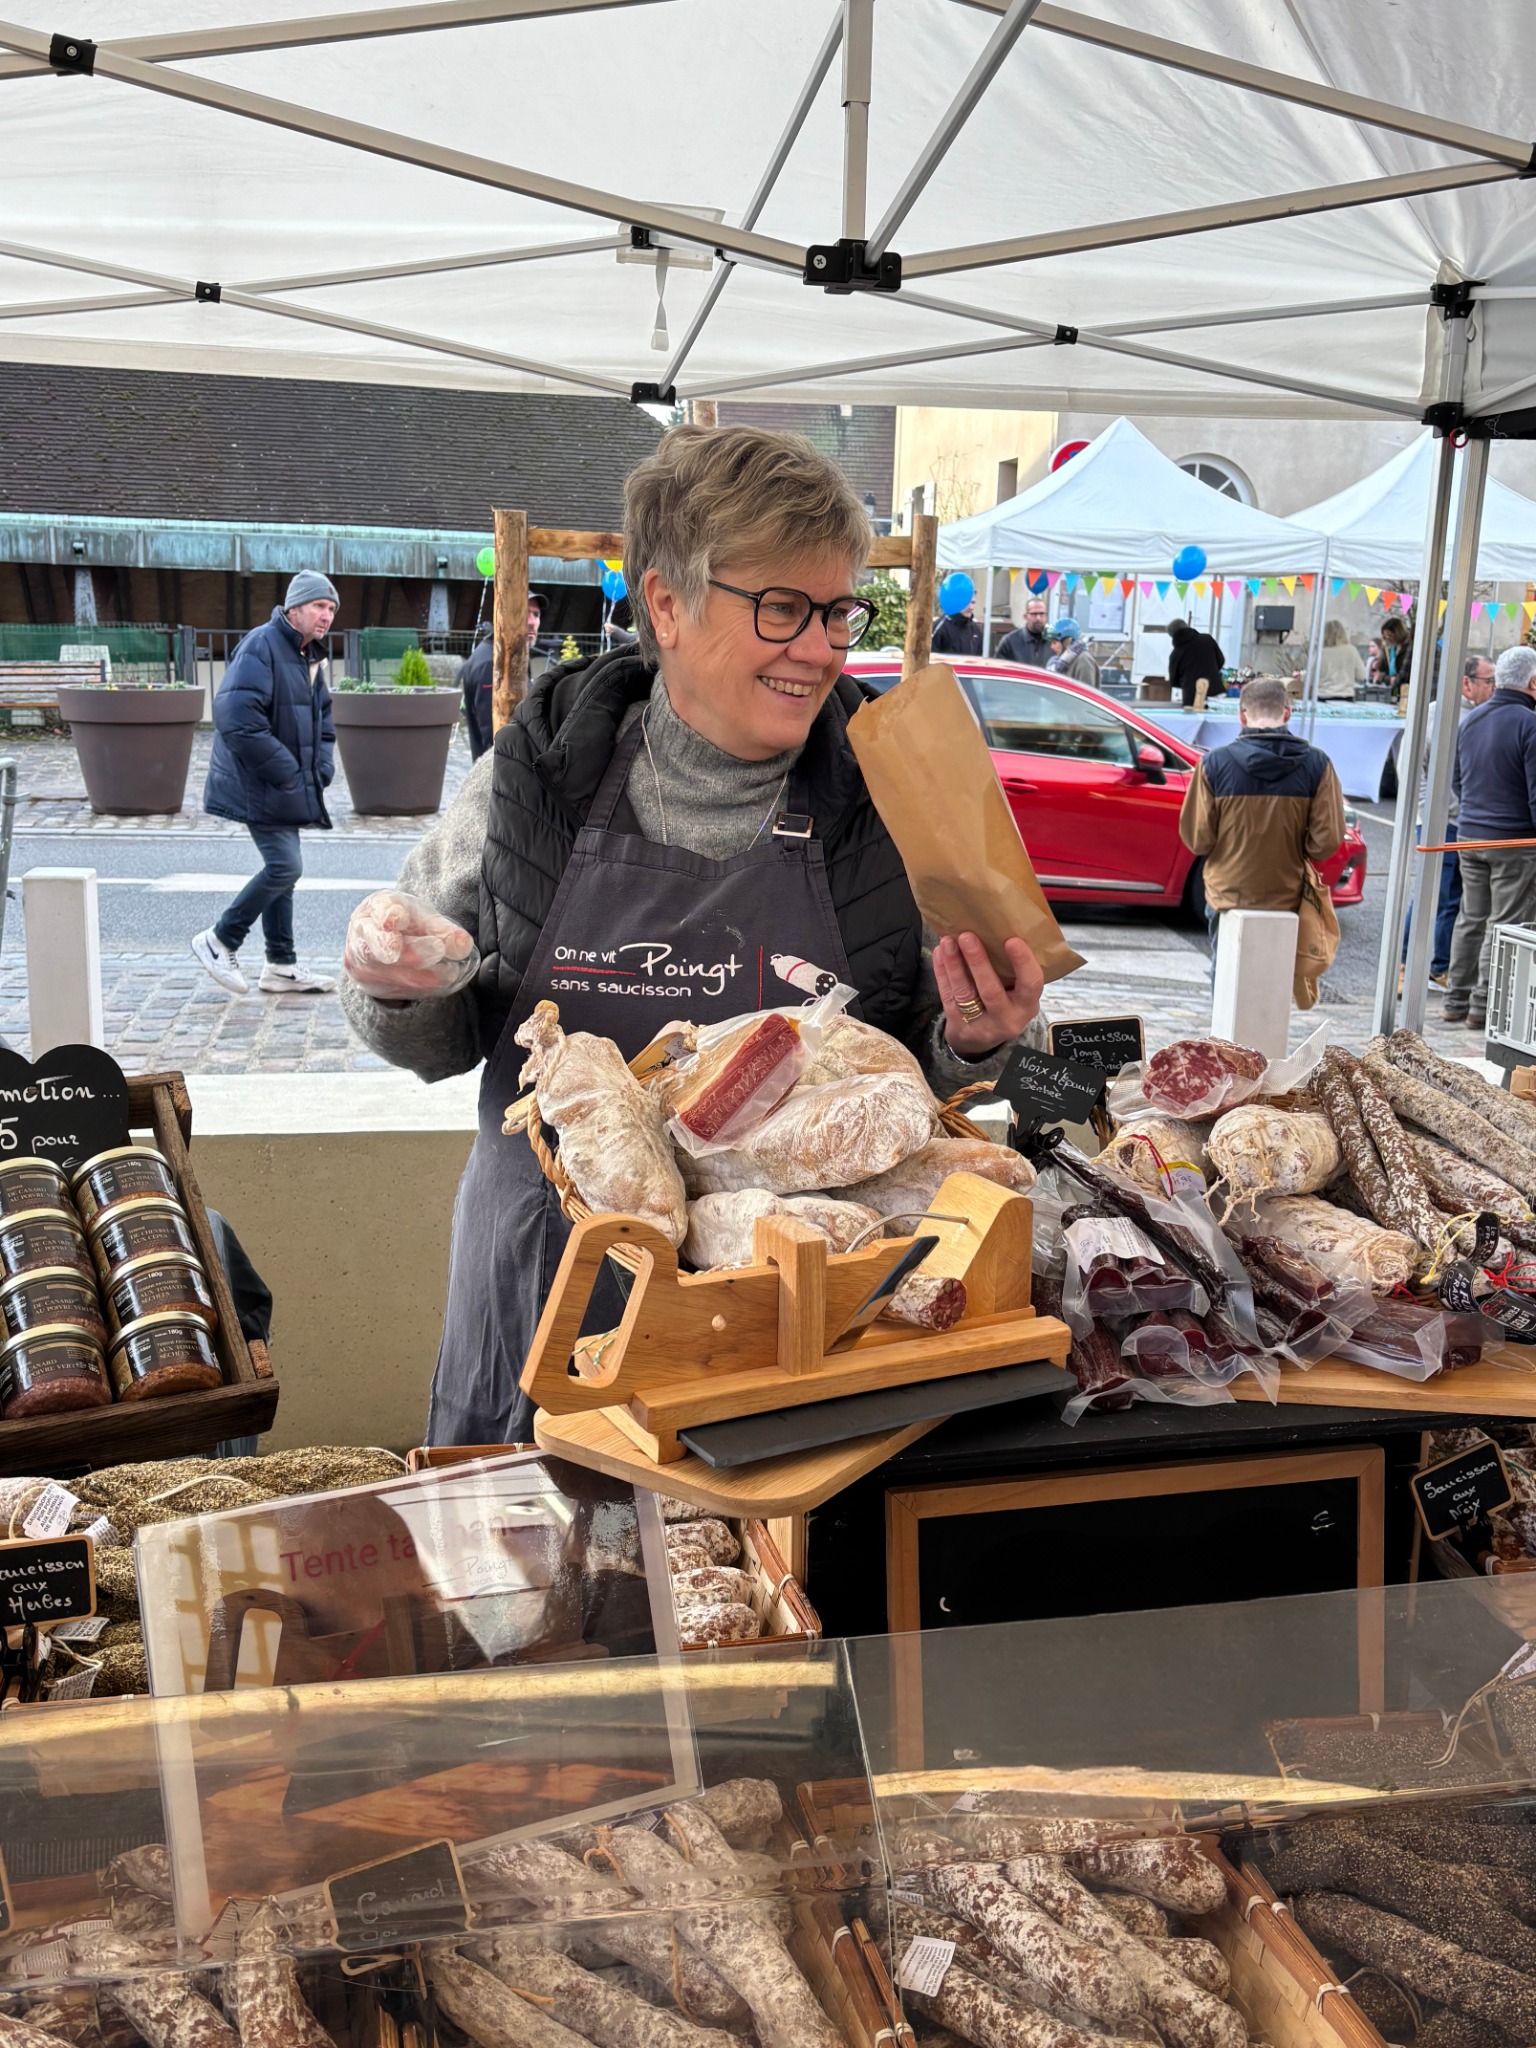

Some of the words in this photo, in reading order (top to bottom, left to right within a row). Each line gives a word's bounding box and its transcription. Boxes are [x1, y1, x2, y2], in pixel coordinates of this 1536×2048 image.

[554, 946, 577, 961] On
[579, 950, 597, 963] ne
[601, 949, 617, 964] vit
[618, 942, 744, 996] Poingt
[550, 978, 591, 992] sans
[597, 982, 692, 998] saucisson
[1018, 1056, 1050, 1077] Noix
[31, 1134, 80, 1154] pour
[167, 1328, 183, 1336] 180g
[1424, 1461, 1498, 1499] Saucisson
[1452, 1485, 1477, 1501] aux
[26, 1494, 47, 1526] SAUCISSON
[279, 1547, 379, 1583] Tente
[12, 1580, 47, 1594] aux
